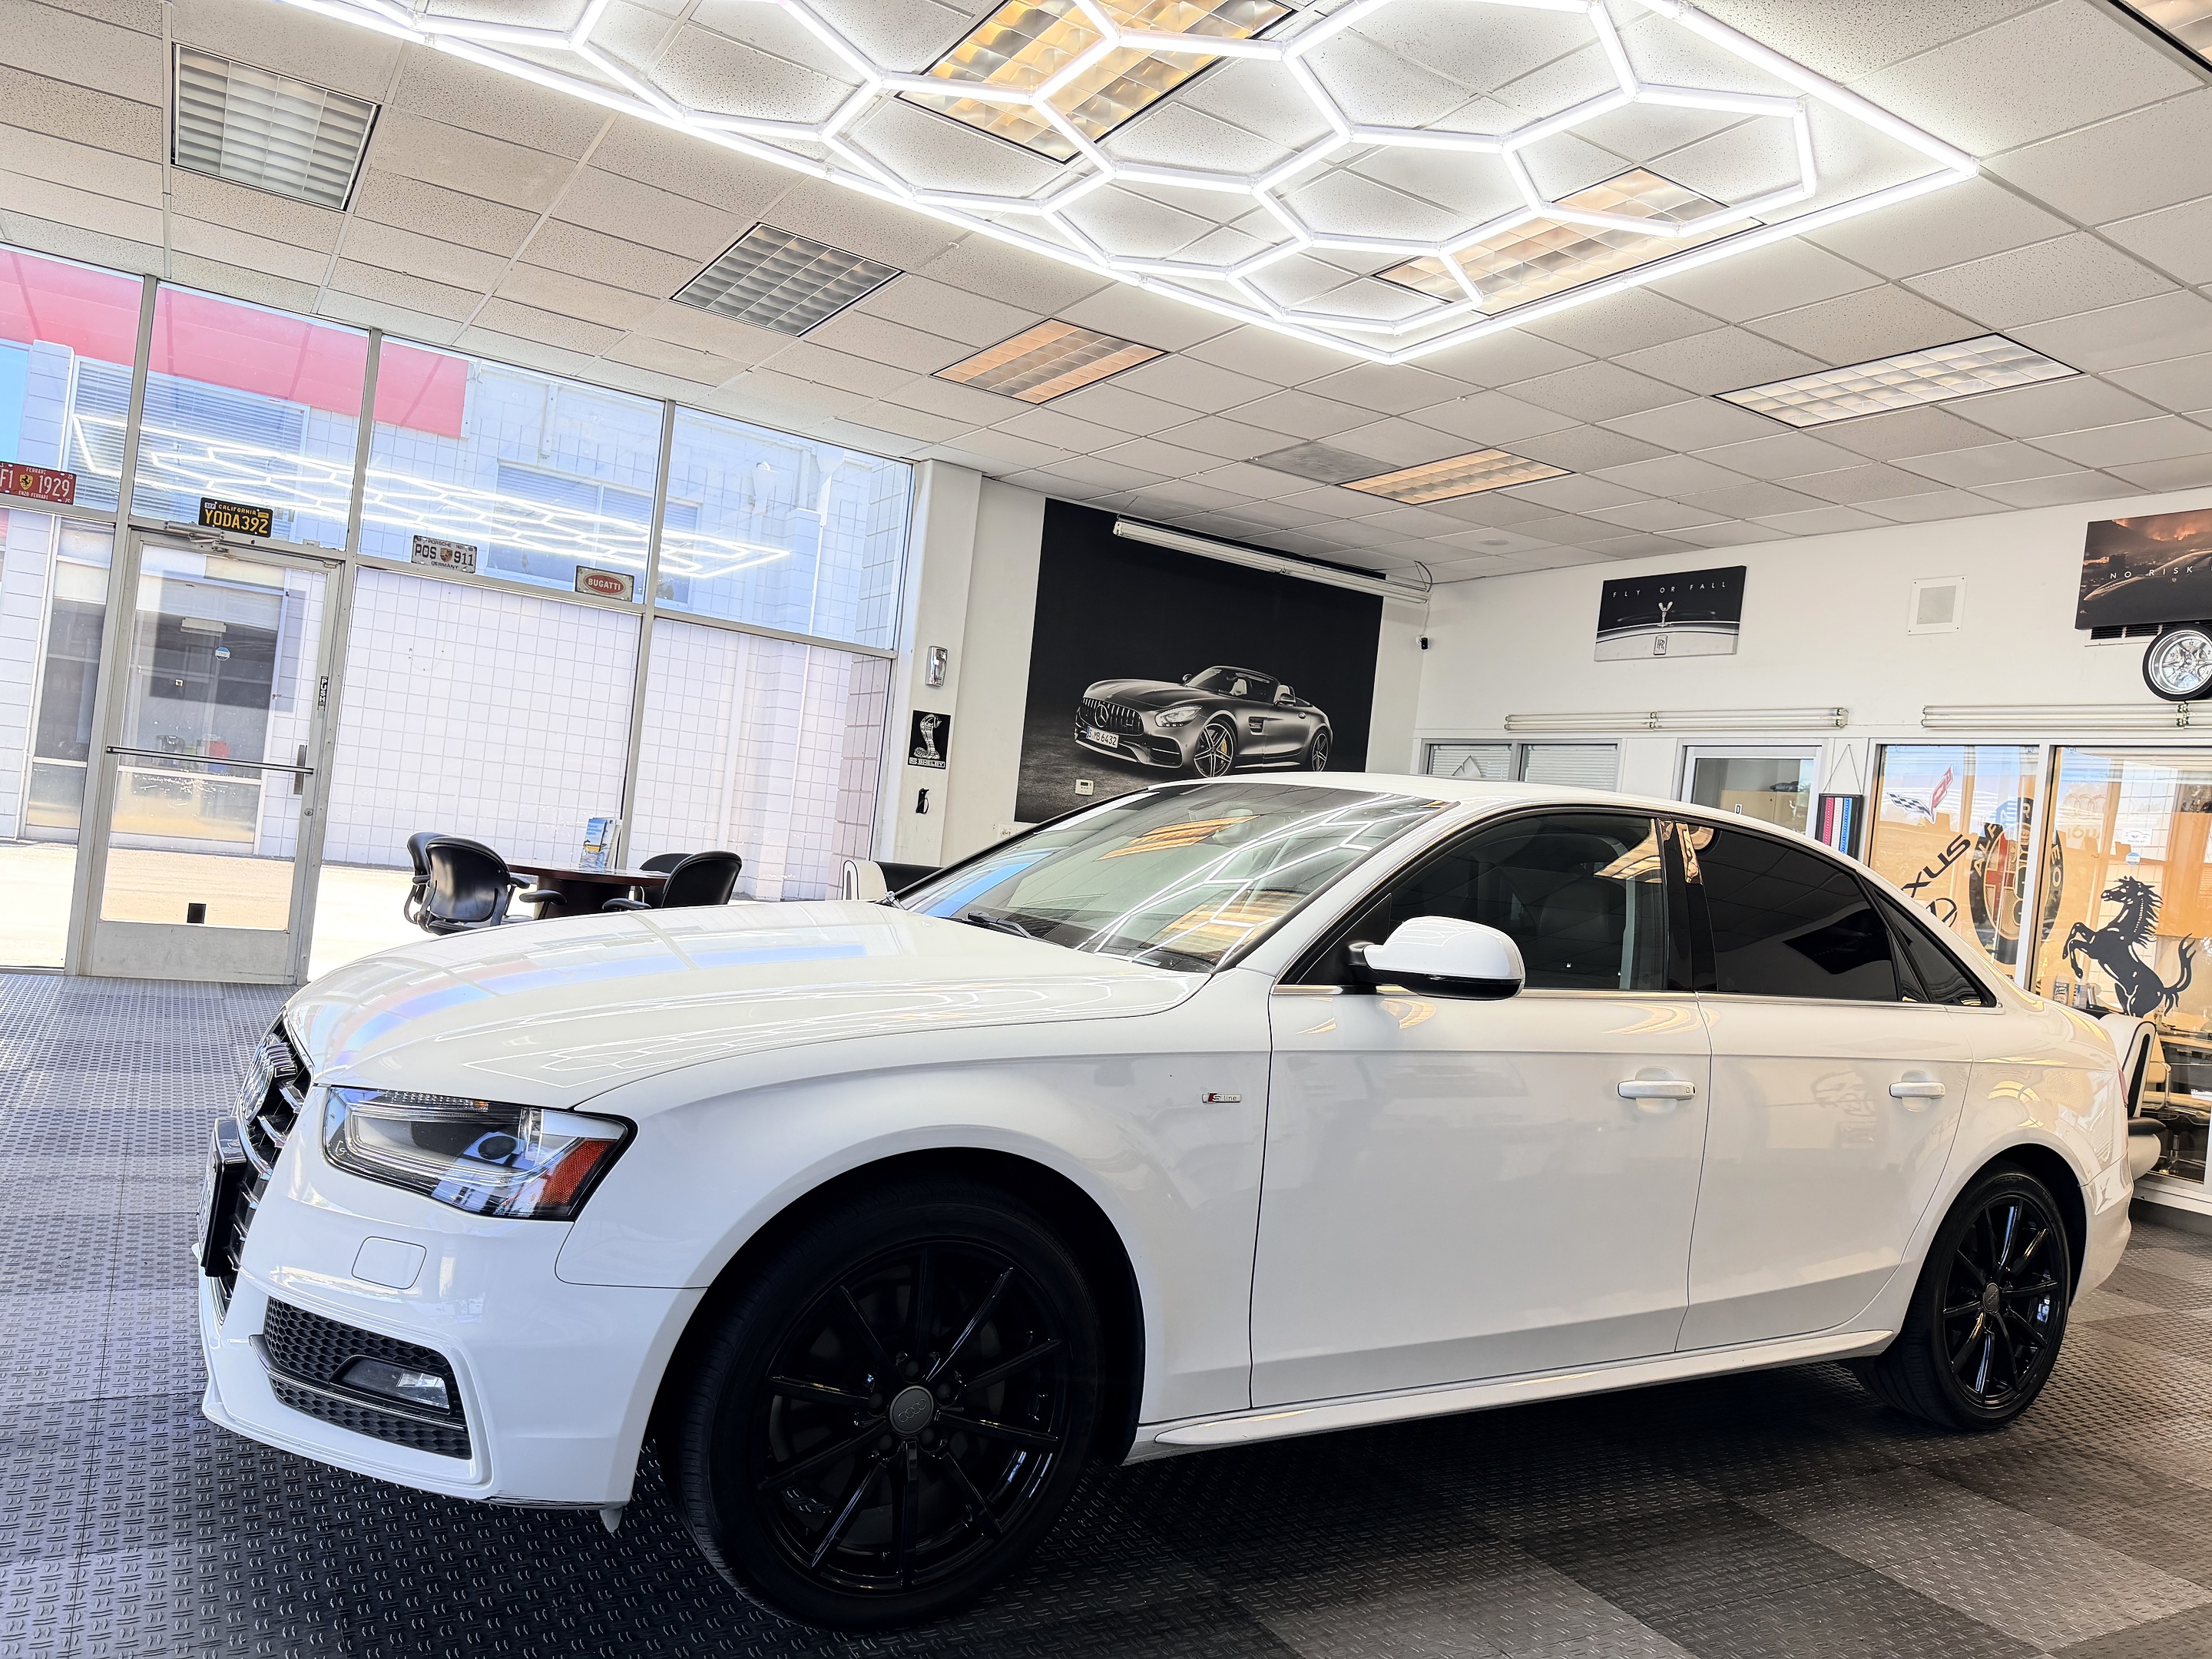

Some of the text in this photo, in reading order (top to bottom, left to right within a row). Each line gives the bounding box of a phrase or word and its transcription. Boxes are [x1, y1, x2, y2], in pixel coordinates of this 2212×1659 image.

[0, 469, 70, 498] F1 1929
[218, 504, 257, 515] CALIFORNIA
[204, 508, 268, 534] YODA392
[415, 544, 474, 566] POS 911
[2110, 566, 2193, 579] NO RISK
[588, 578, 621, 591] BUGATTI
[1690, 581, 1726, 591] FALL
[1101, 733, 1117, 746] 6432
[1902, 833, 1971, 899] XUS
